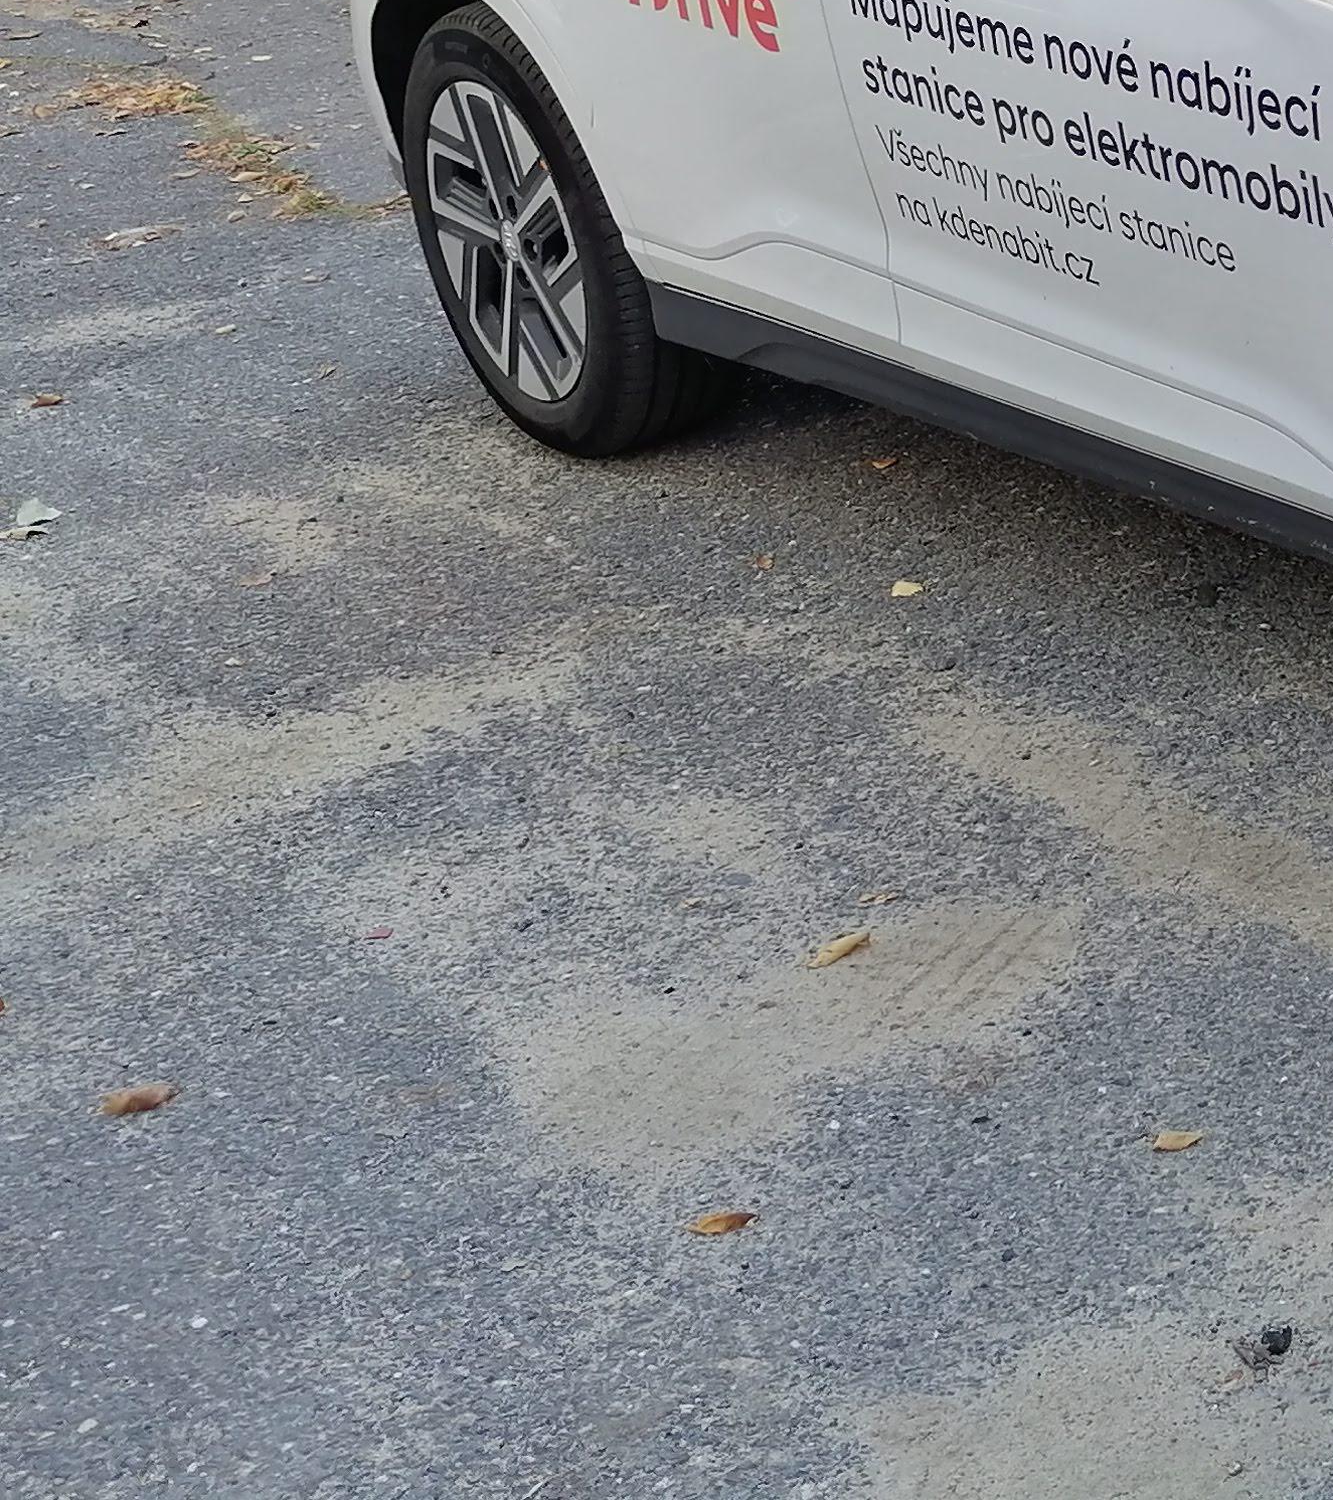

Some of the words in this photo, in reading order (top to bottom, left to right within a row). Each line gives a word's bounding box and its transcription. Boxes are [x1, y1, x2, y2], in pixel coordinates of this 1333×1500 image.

[862, 55, 986, 126] stanice
[992, 98, 1054, 147] pro
[1043, 33, 1139, 92] nové
[1149, 60, 1321, 141] nabíjecí
[875, 125, 988, 201] Všechny
[996, 172, 1112, 233] nabíjecí
[1120, 210, 1236, 272] stanice
[896, 192, 932, 227] na
[933, 197, 1100, 286] kdenabit.cz
